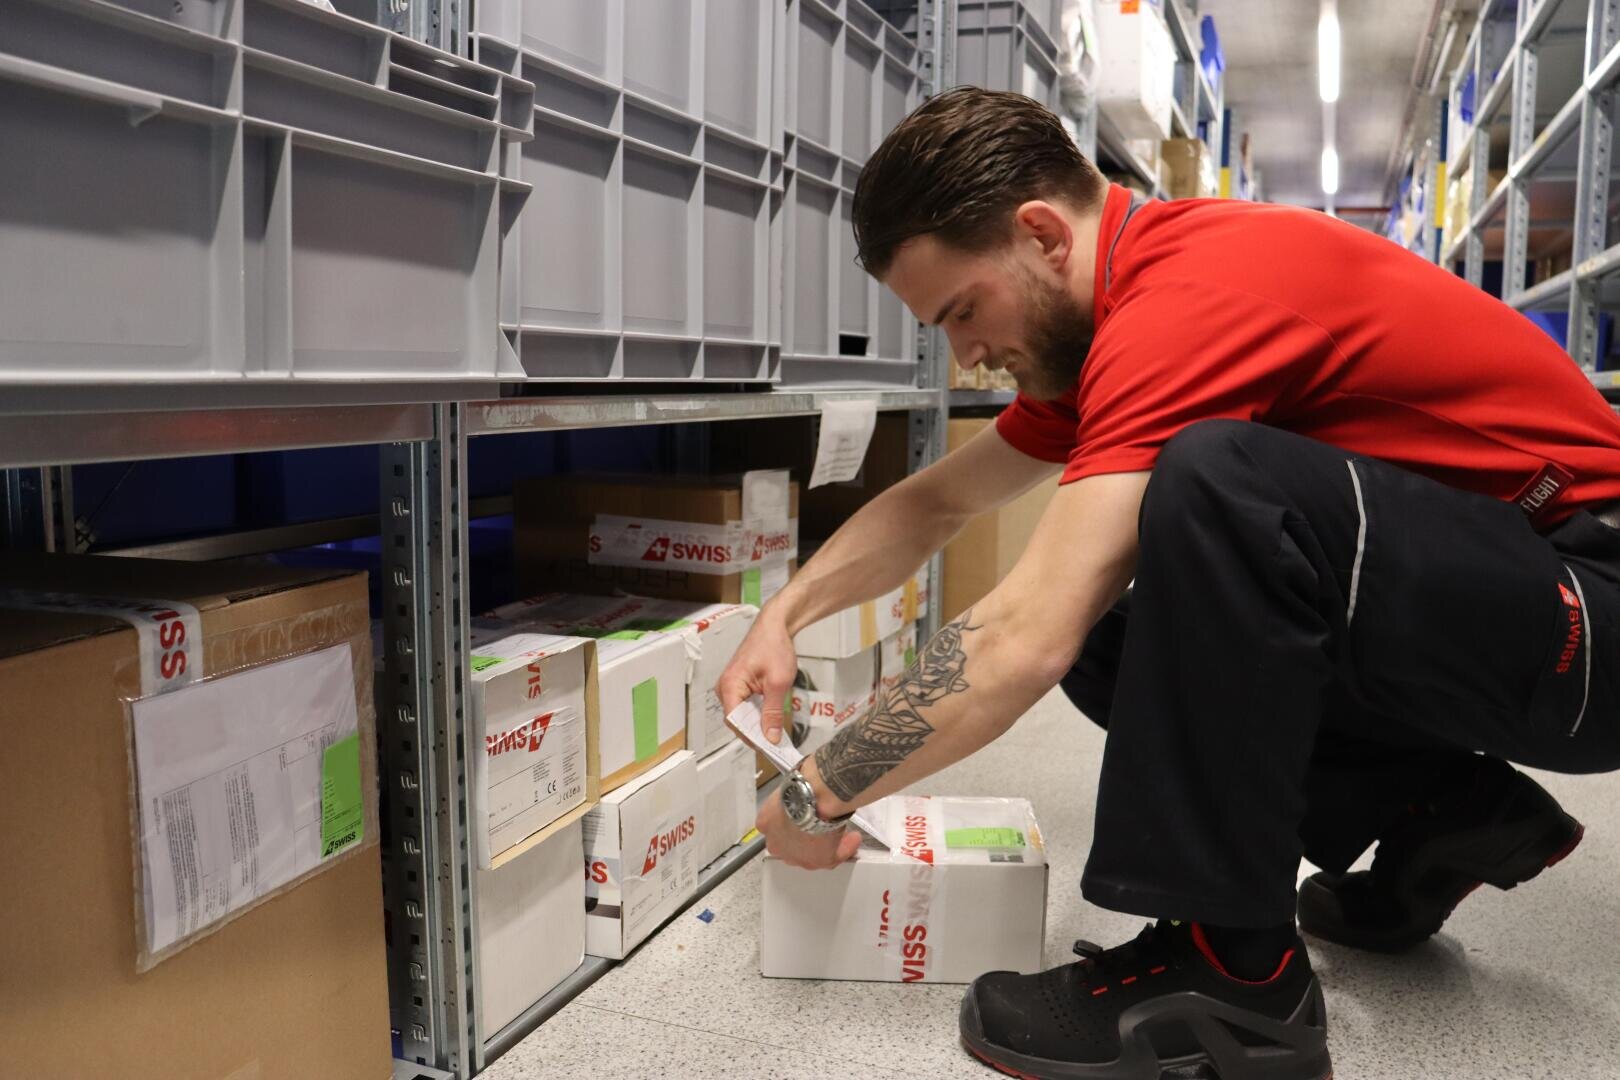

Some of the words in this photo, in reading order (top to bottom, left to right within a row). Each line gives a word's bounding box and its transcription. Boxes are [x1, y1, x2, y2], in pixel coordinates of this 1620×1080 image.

[1520, 474, 1560, 513] FLIGHT
[672, 542, 731, 563] SWISS
[1556, 610, 1581, 674] SWISS
[334, 831, 356, 849] SWISS
[660, 815, 695, 856] SWISS
[906, 815, 927, 848] SWISS
